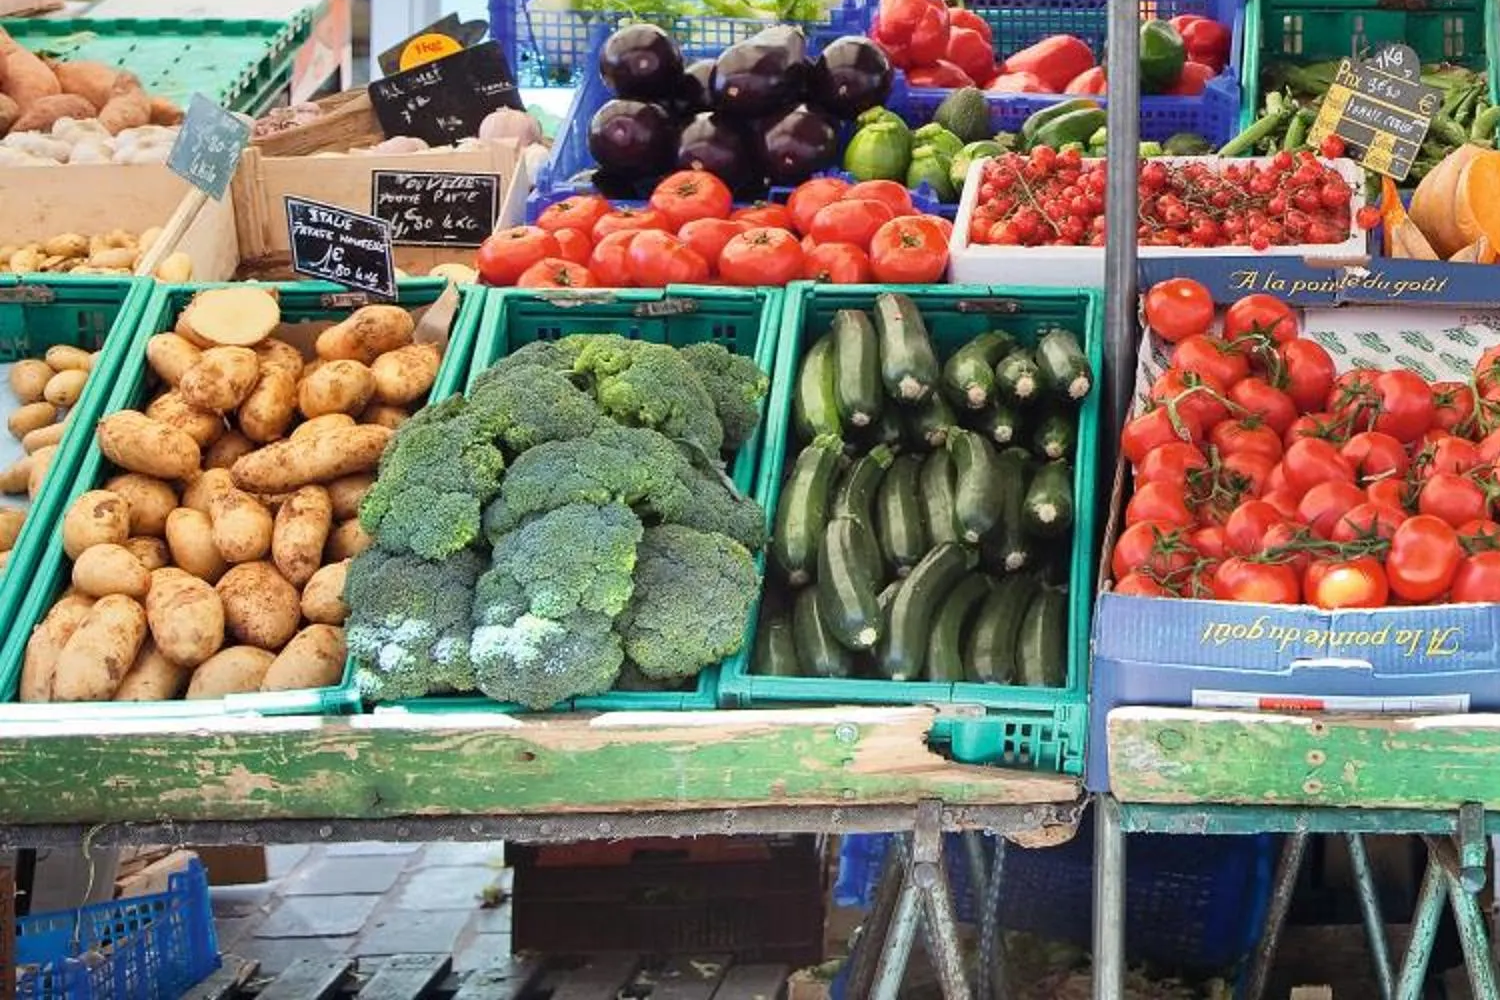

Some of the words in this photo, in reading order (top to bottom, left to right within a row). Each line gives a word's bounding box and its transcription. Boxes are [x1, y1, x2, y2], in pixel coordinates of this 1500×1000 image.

[1263, 271, 1286, 292] la
[1362, 270, 1391, 294] du
[1392, 273, 1451, 298] goût
